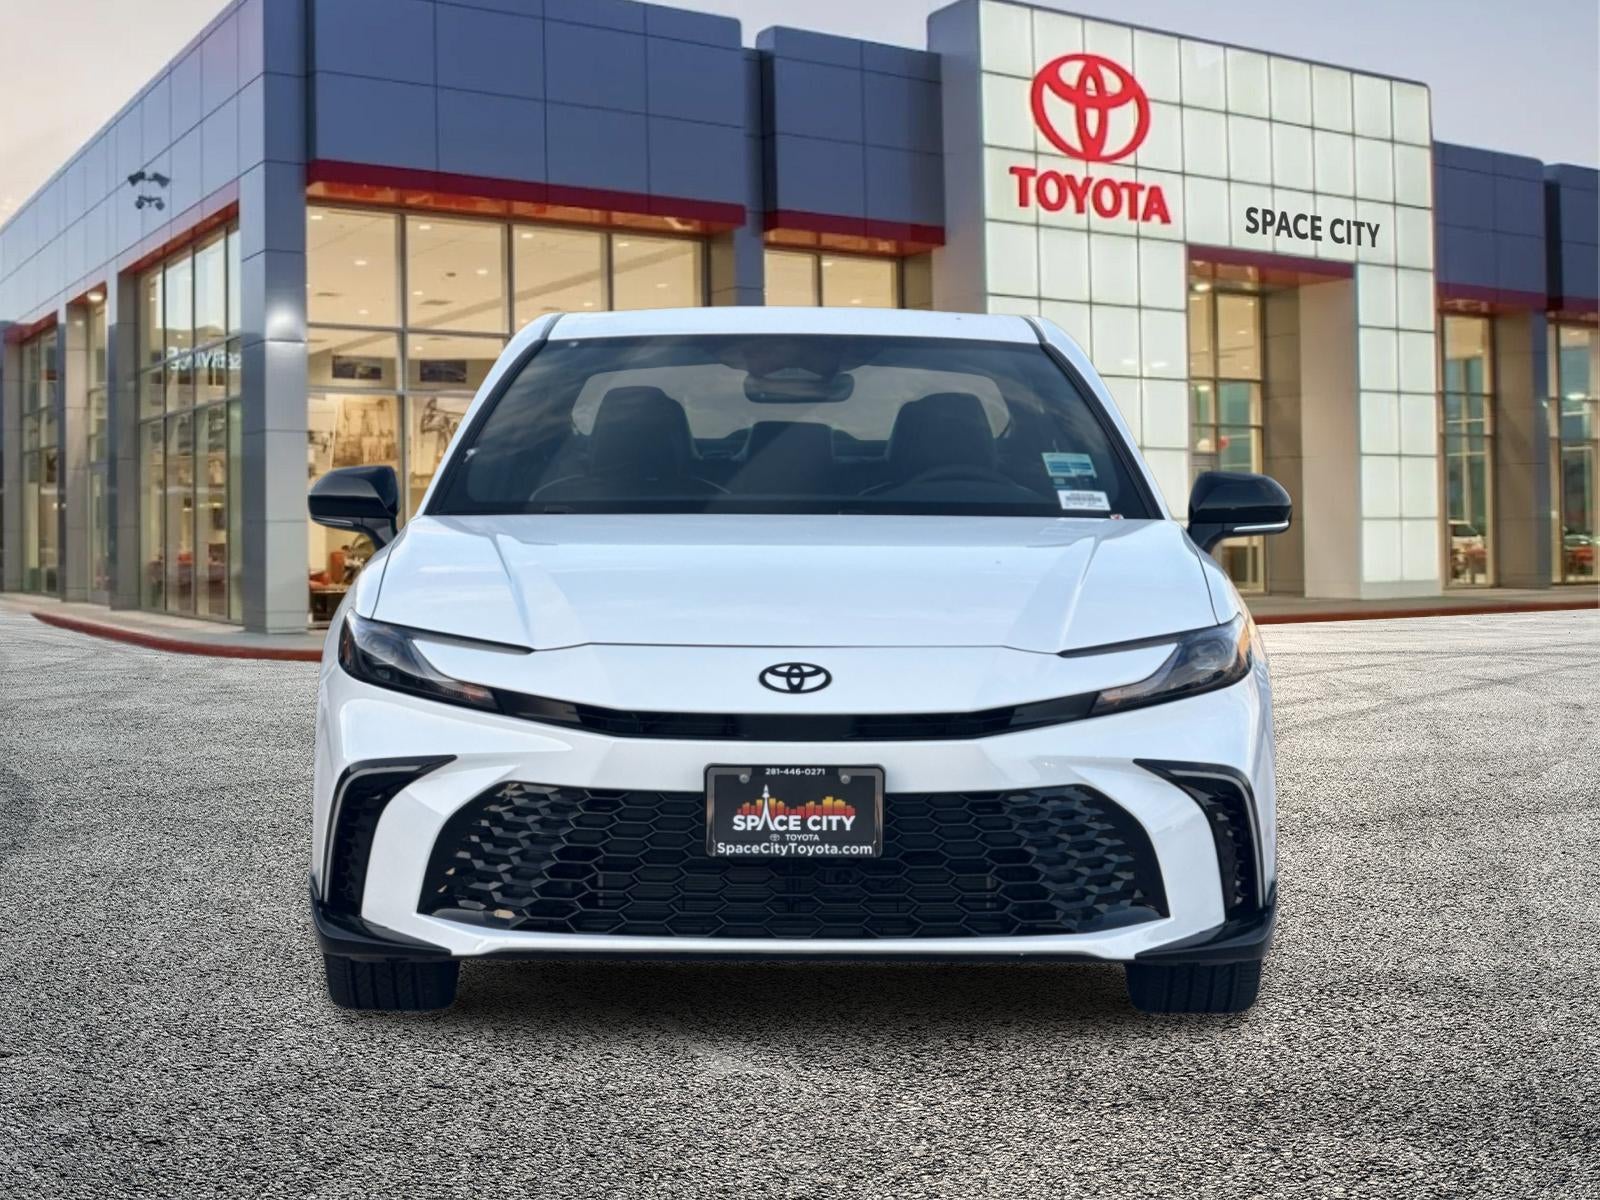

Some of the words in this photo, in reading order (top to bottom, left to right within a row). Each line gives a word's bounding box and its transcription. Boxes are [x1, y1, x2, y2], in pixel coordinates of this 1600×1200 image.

[1009, 166, 1171, 225] TOYOTA
[1245, 206, 1323, 242] SPACE
[1329, 218, 1381, 248] CITY
[765, 767, 826, 776] 281-446-0271
[732, 814, 802, 831] SPACE
[807, 814, 856, 831] CITY
[785, 833, 820, 842] TOYOTA
[716, 842, 873, 856] SpaceCityToyota.com
